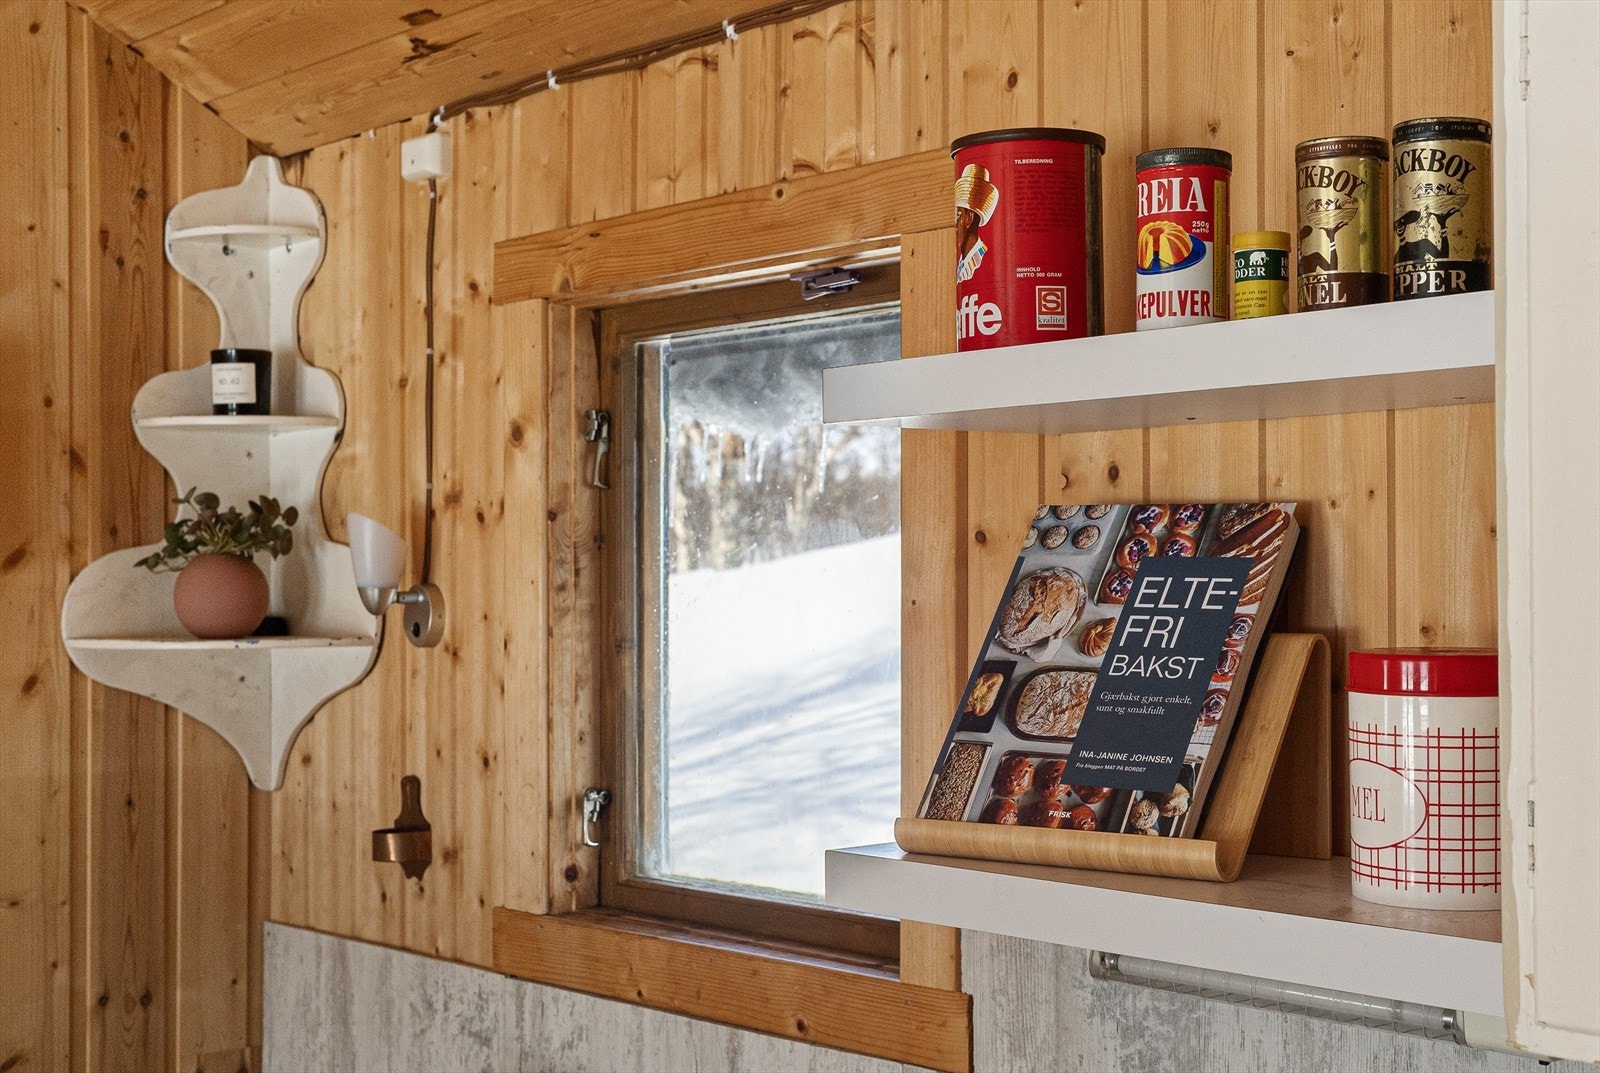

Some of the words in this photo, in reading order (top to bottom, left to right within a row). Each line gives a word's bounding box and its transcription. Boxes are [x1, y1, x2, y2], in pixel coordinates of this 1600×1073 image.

[1296, 165, 1366, 198] CK-BOY
[1138, 176, 1208, 218] REIA
[1192, 220, 1210, 228] 250g
[1396, 270, 1467, 296] PPER
[1042, 291, 1060, 312] S
[1038, 316, 1065, 324] kvalitet
[1134, 576, 1238, 610] ELTE-
[1118, 615, 1184, 648] FRI
[1108, 654, 1204, 680] BAKST
[1100, 691, 1140, 704] Gjærbakst
[1141, 693, 1164, 705] gjort
[1164, 695, 1192, 705] enkelt,
[1114, 707, 1126, 715] og
[1127, 706, 1164, 715] smakfullt
[1078, 750, 1128, 761] INA-JANINE
[1130, 754, 1174, 764] JOHNSEN
[1048, 810, 1072, 819] FRISK
[1352, 784, 1386, 824] MEL
